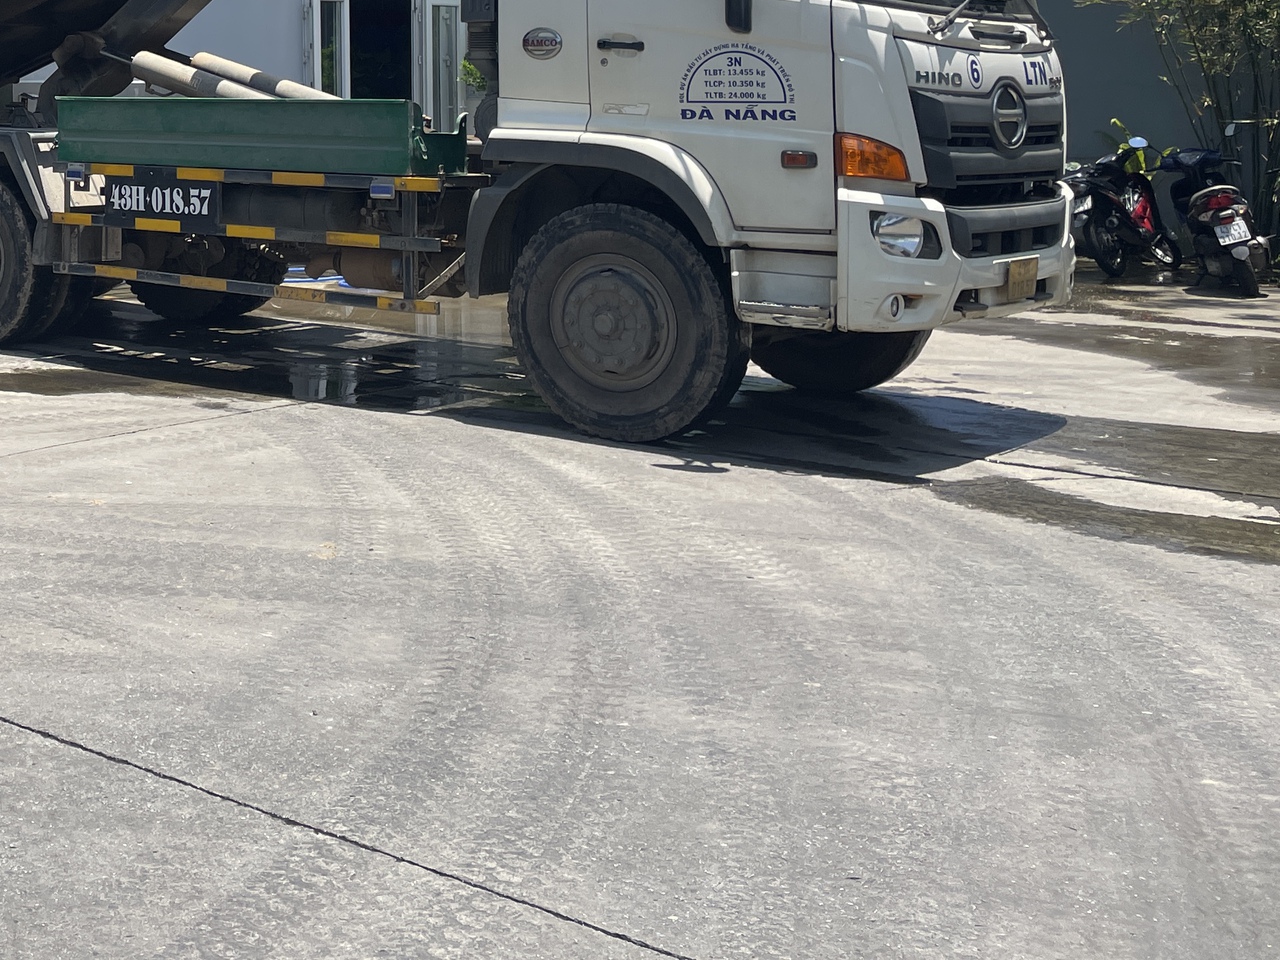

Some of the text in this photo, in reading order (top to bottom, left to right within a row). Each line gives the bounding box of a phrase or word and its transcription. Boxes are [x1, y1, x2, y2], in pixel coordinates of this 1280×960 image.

[523, 38, 558, 47] SAMCO
[726, 57, 742, 67] 3N
[756, 68, 766, 77] kg
[970, 59, 981, 84] 6
[1023, 61, 1048, 86] LTN
[915, 70, 962, 87] HINO
[756, 80, 766, 88] kg
[756, 92, 767, 100] kg
[680, 106, 714, 120] ĐÀ
